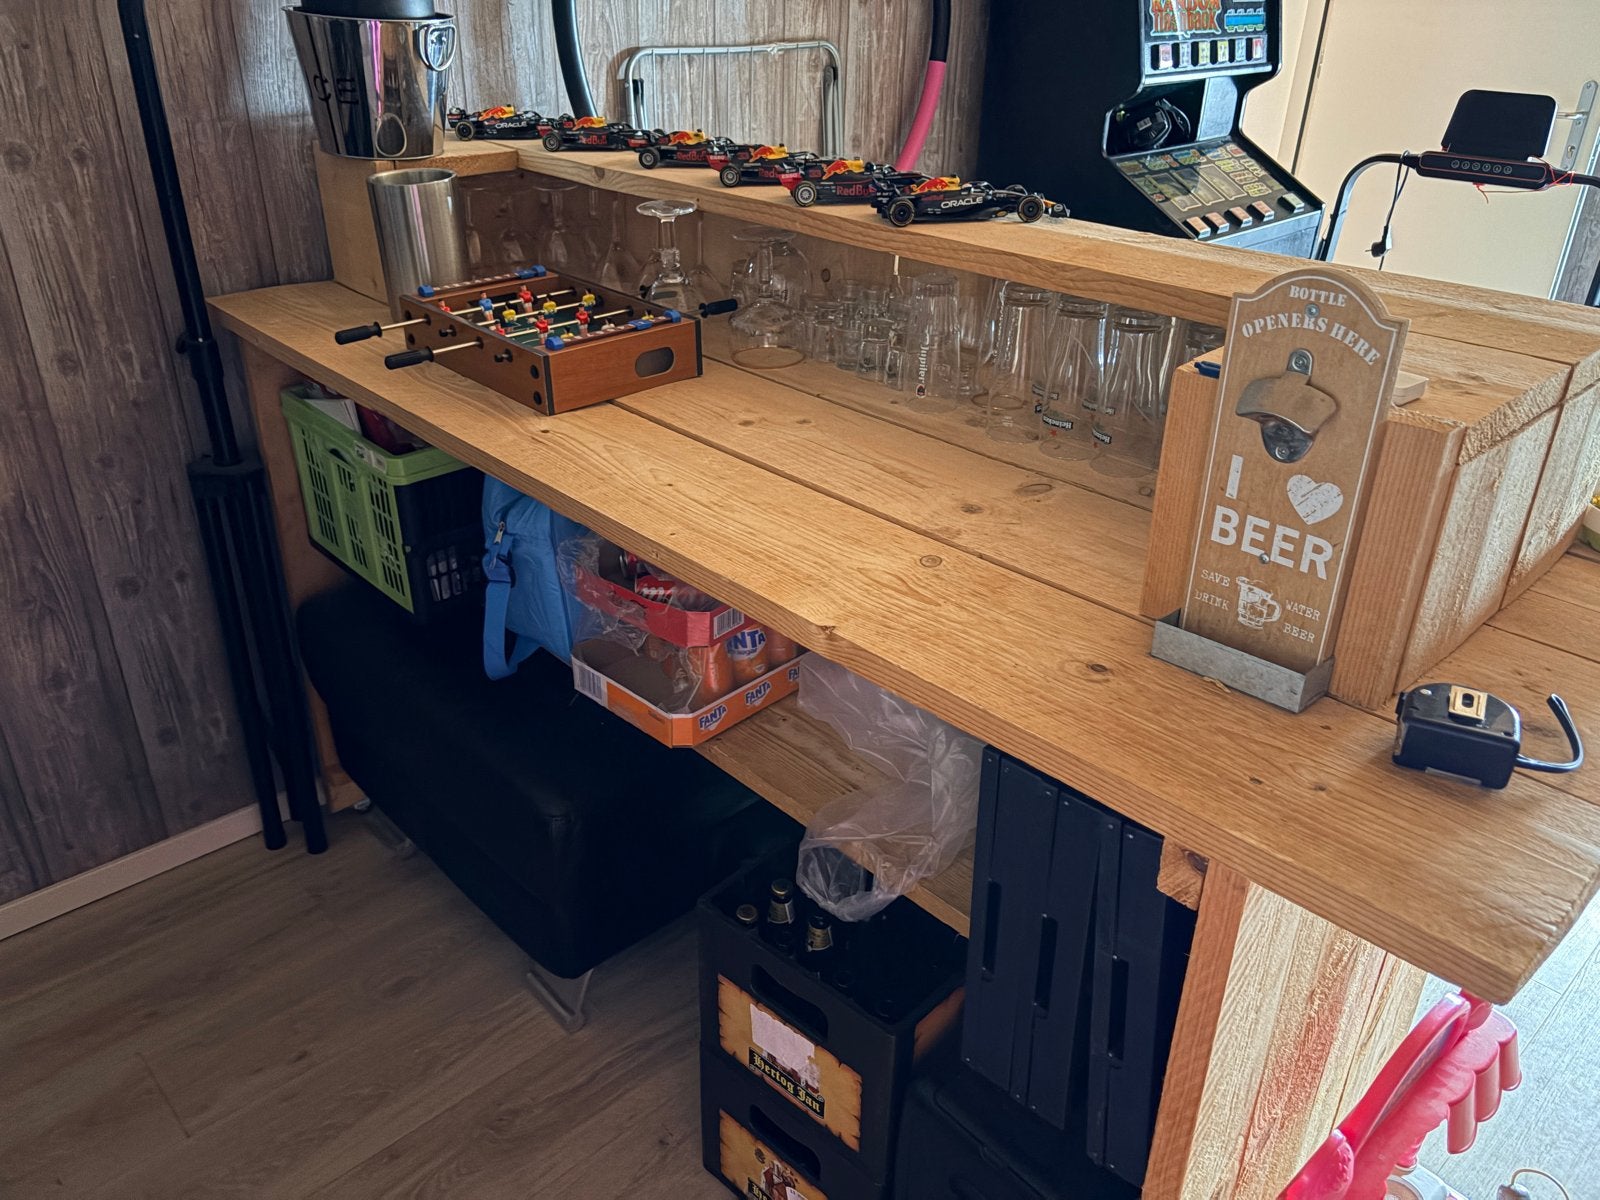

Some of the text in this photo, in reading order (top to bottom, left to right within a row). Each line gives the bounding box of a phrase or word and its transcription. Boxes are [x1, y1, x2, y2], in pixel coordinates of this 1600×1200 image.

[494, 121, 528, 129] ORACLE
[940, 196, 984, 210] ORACLE
[1289, 285, 1347, 308] BOTTLE
[1242, 312, 1381, 366] OPENERS HERE
[918, 344, 930, 384] Jupiler
[1225, 454, 1244, 500] I
[1210, 505, 1334, 580] BEER
[1194, 589, 1316, 643] DRINK BEER
[1200, 569, 1322, 622] SAVE WATER
[745, 681, 771, 704] FANTA
[699, 705, 727, 729] FANTA
[752, 1053, 821, 1113] Hertog Jan
